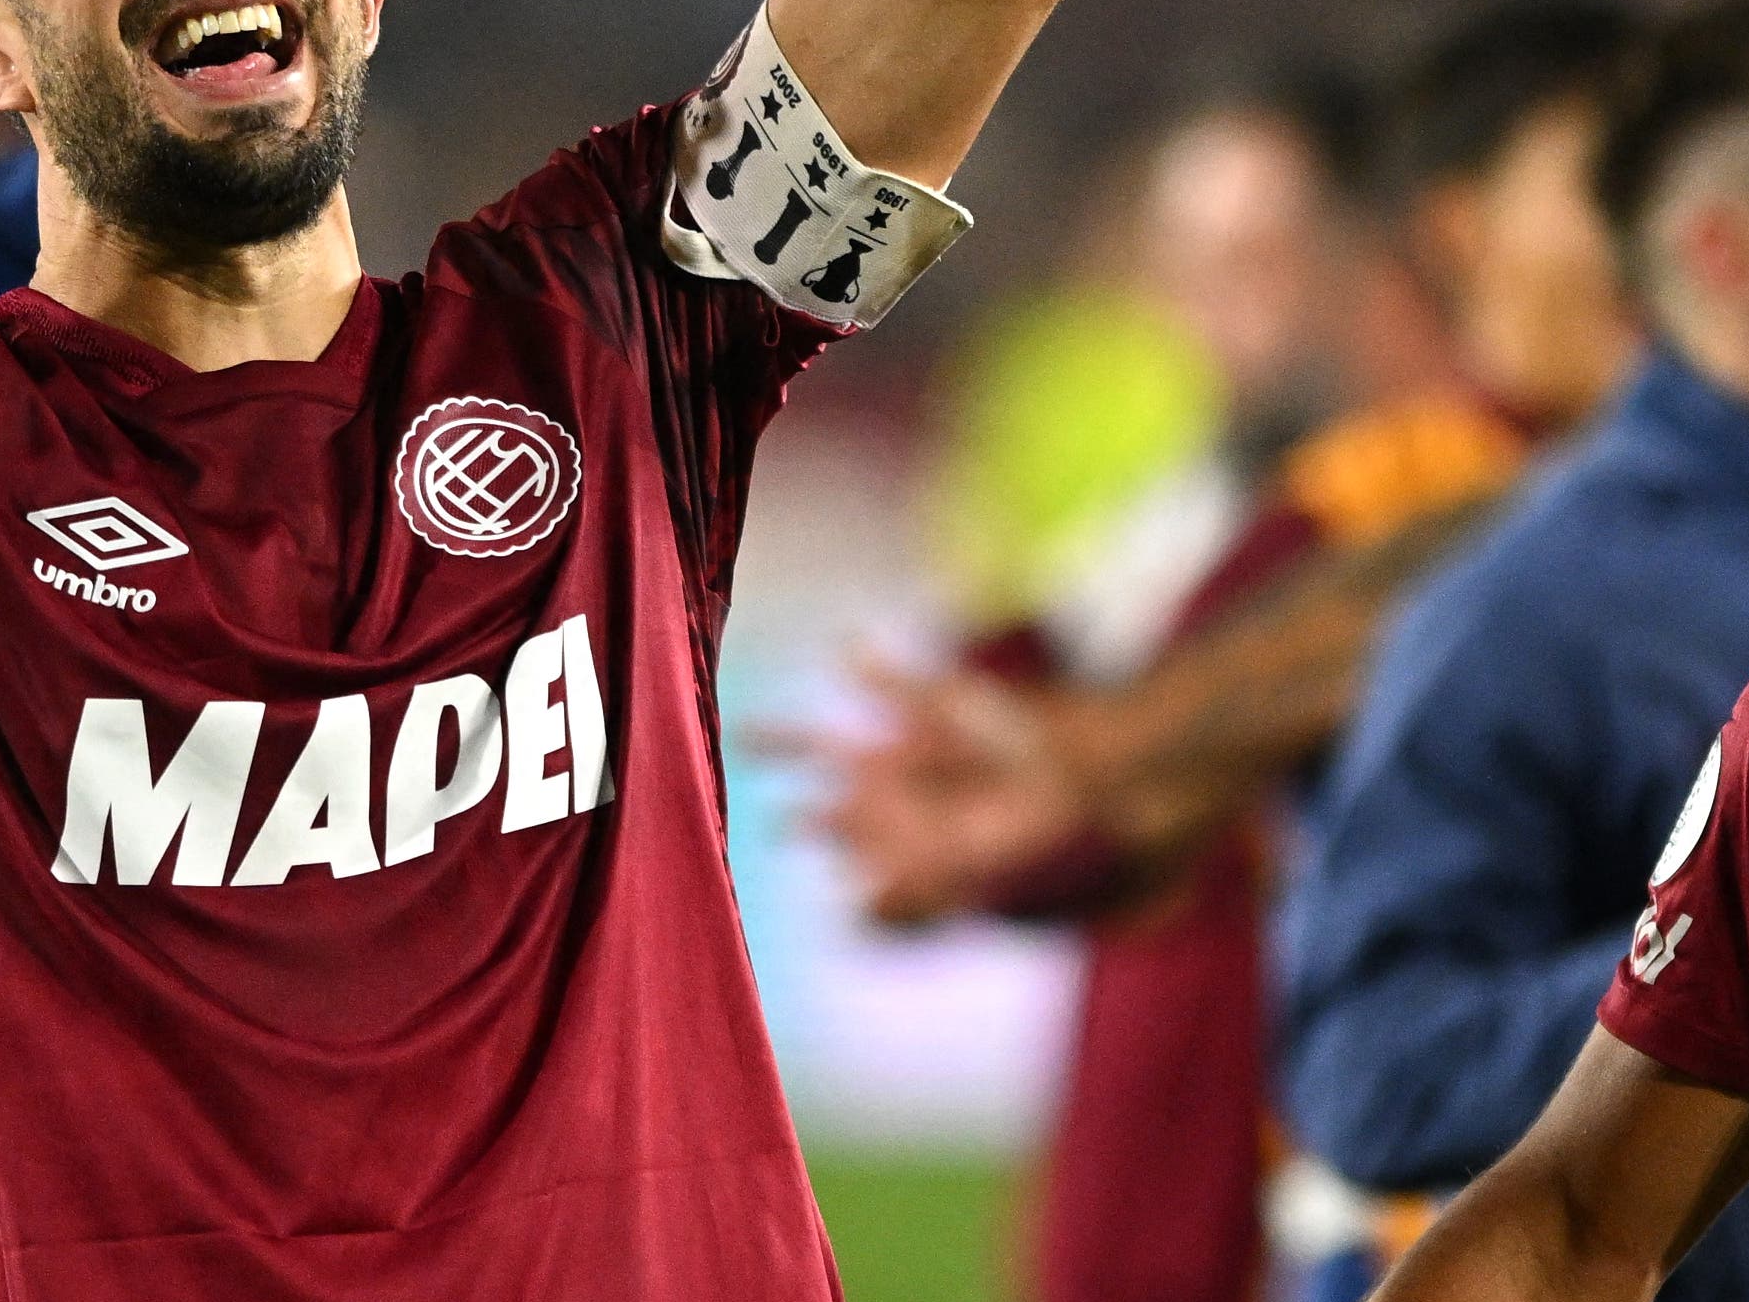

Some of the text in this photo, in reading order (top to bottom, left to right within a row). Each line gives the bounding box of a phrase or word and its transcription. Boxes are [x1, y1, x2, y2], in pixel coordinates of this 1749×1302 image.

[769, 63, 802, 109] 2007
[811, 131, 850, 180] 1996
[33, 556, 157, 613] umbro
[51, 613, 615, 887] MAPEI
